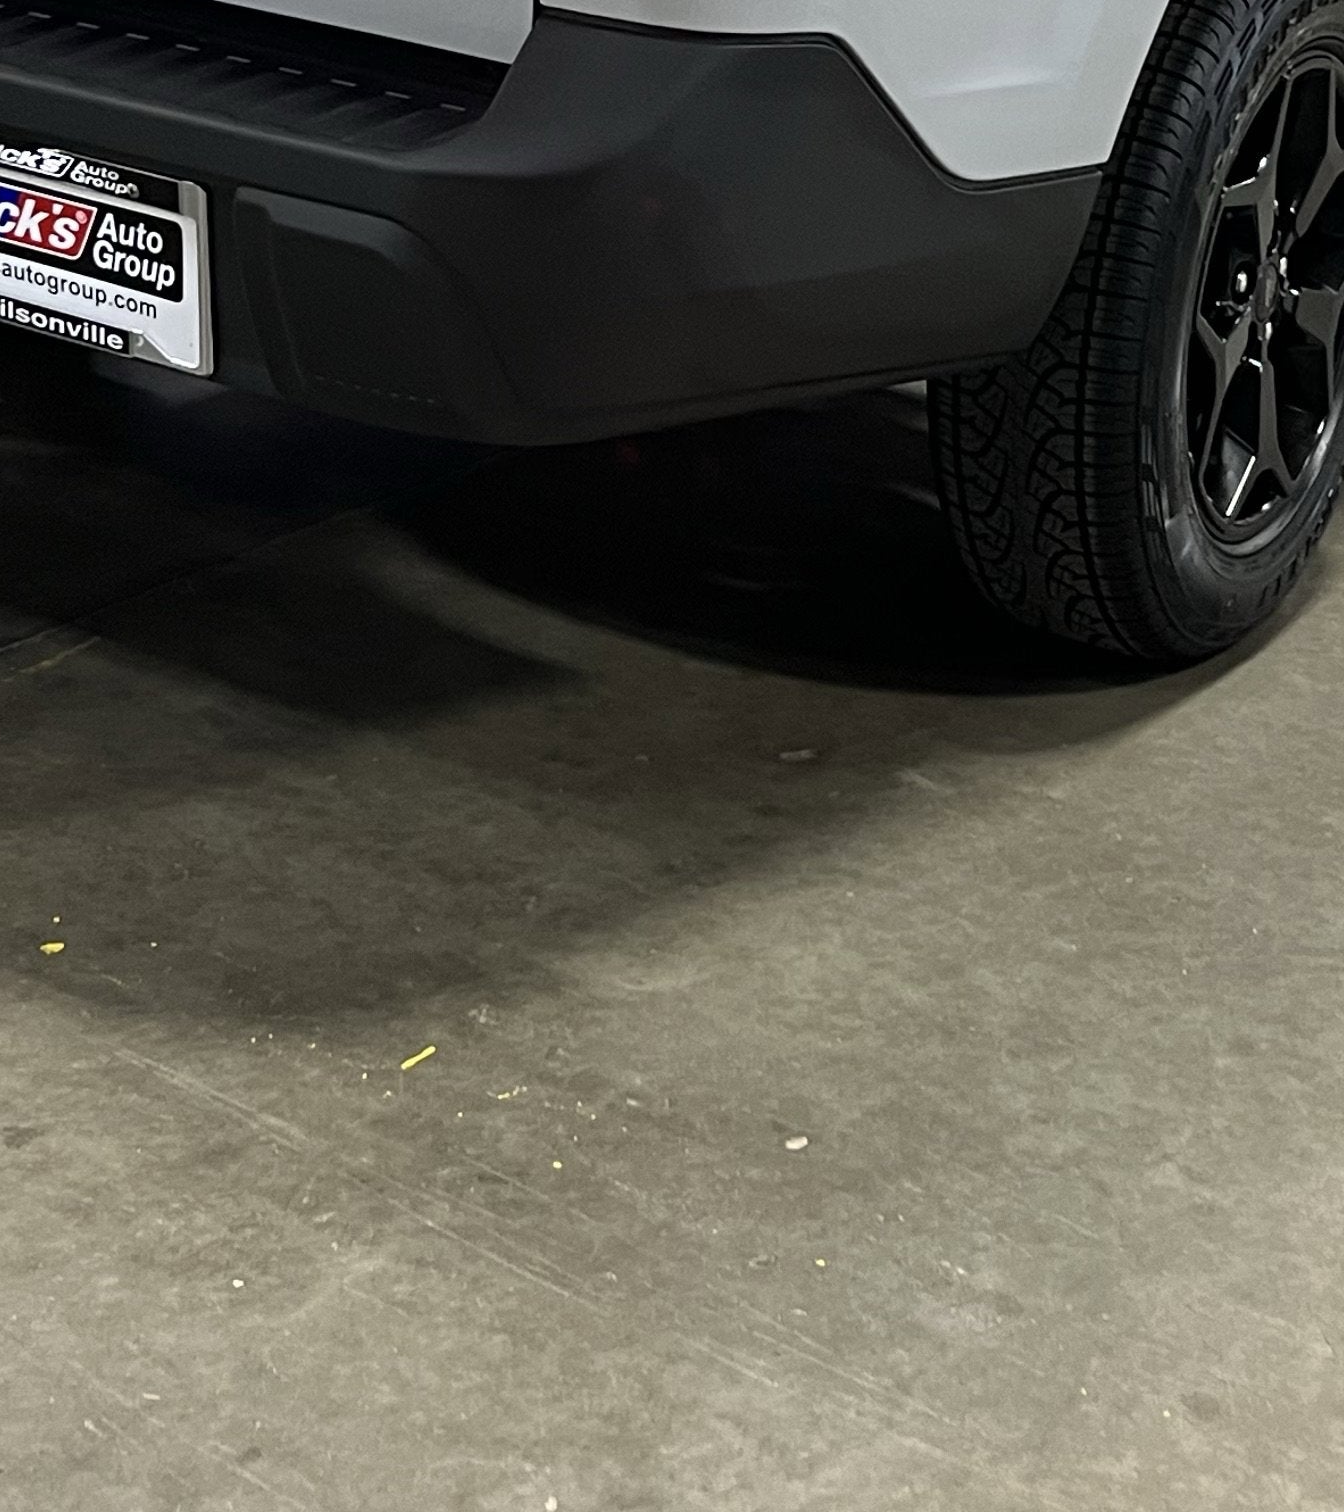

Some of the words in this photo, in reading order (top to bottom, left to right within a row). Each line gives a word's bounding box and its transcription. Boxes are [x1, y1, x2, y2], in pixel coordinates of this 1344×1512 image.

[69, 169, 128, 195] Group
[72, 160, 120, 181] Auto
[96, 211, 164, 254] Auto
[92, 239, 176, 291] Group
